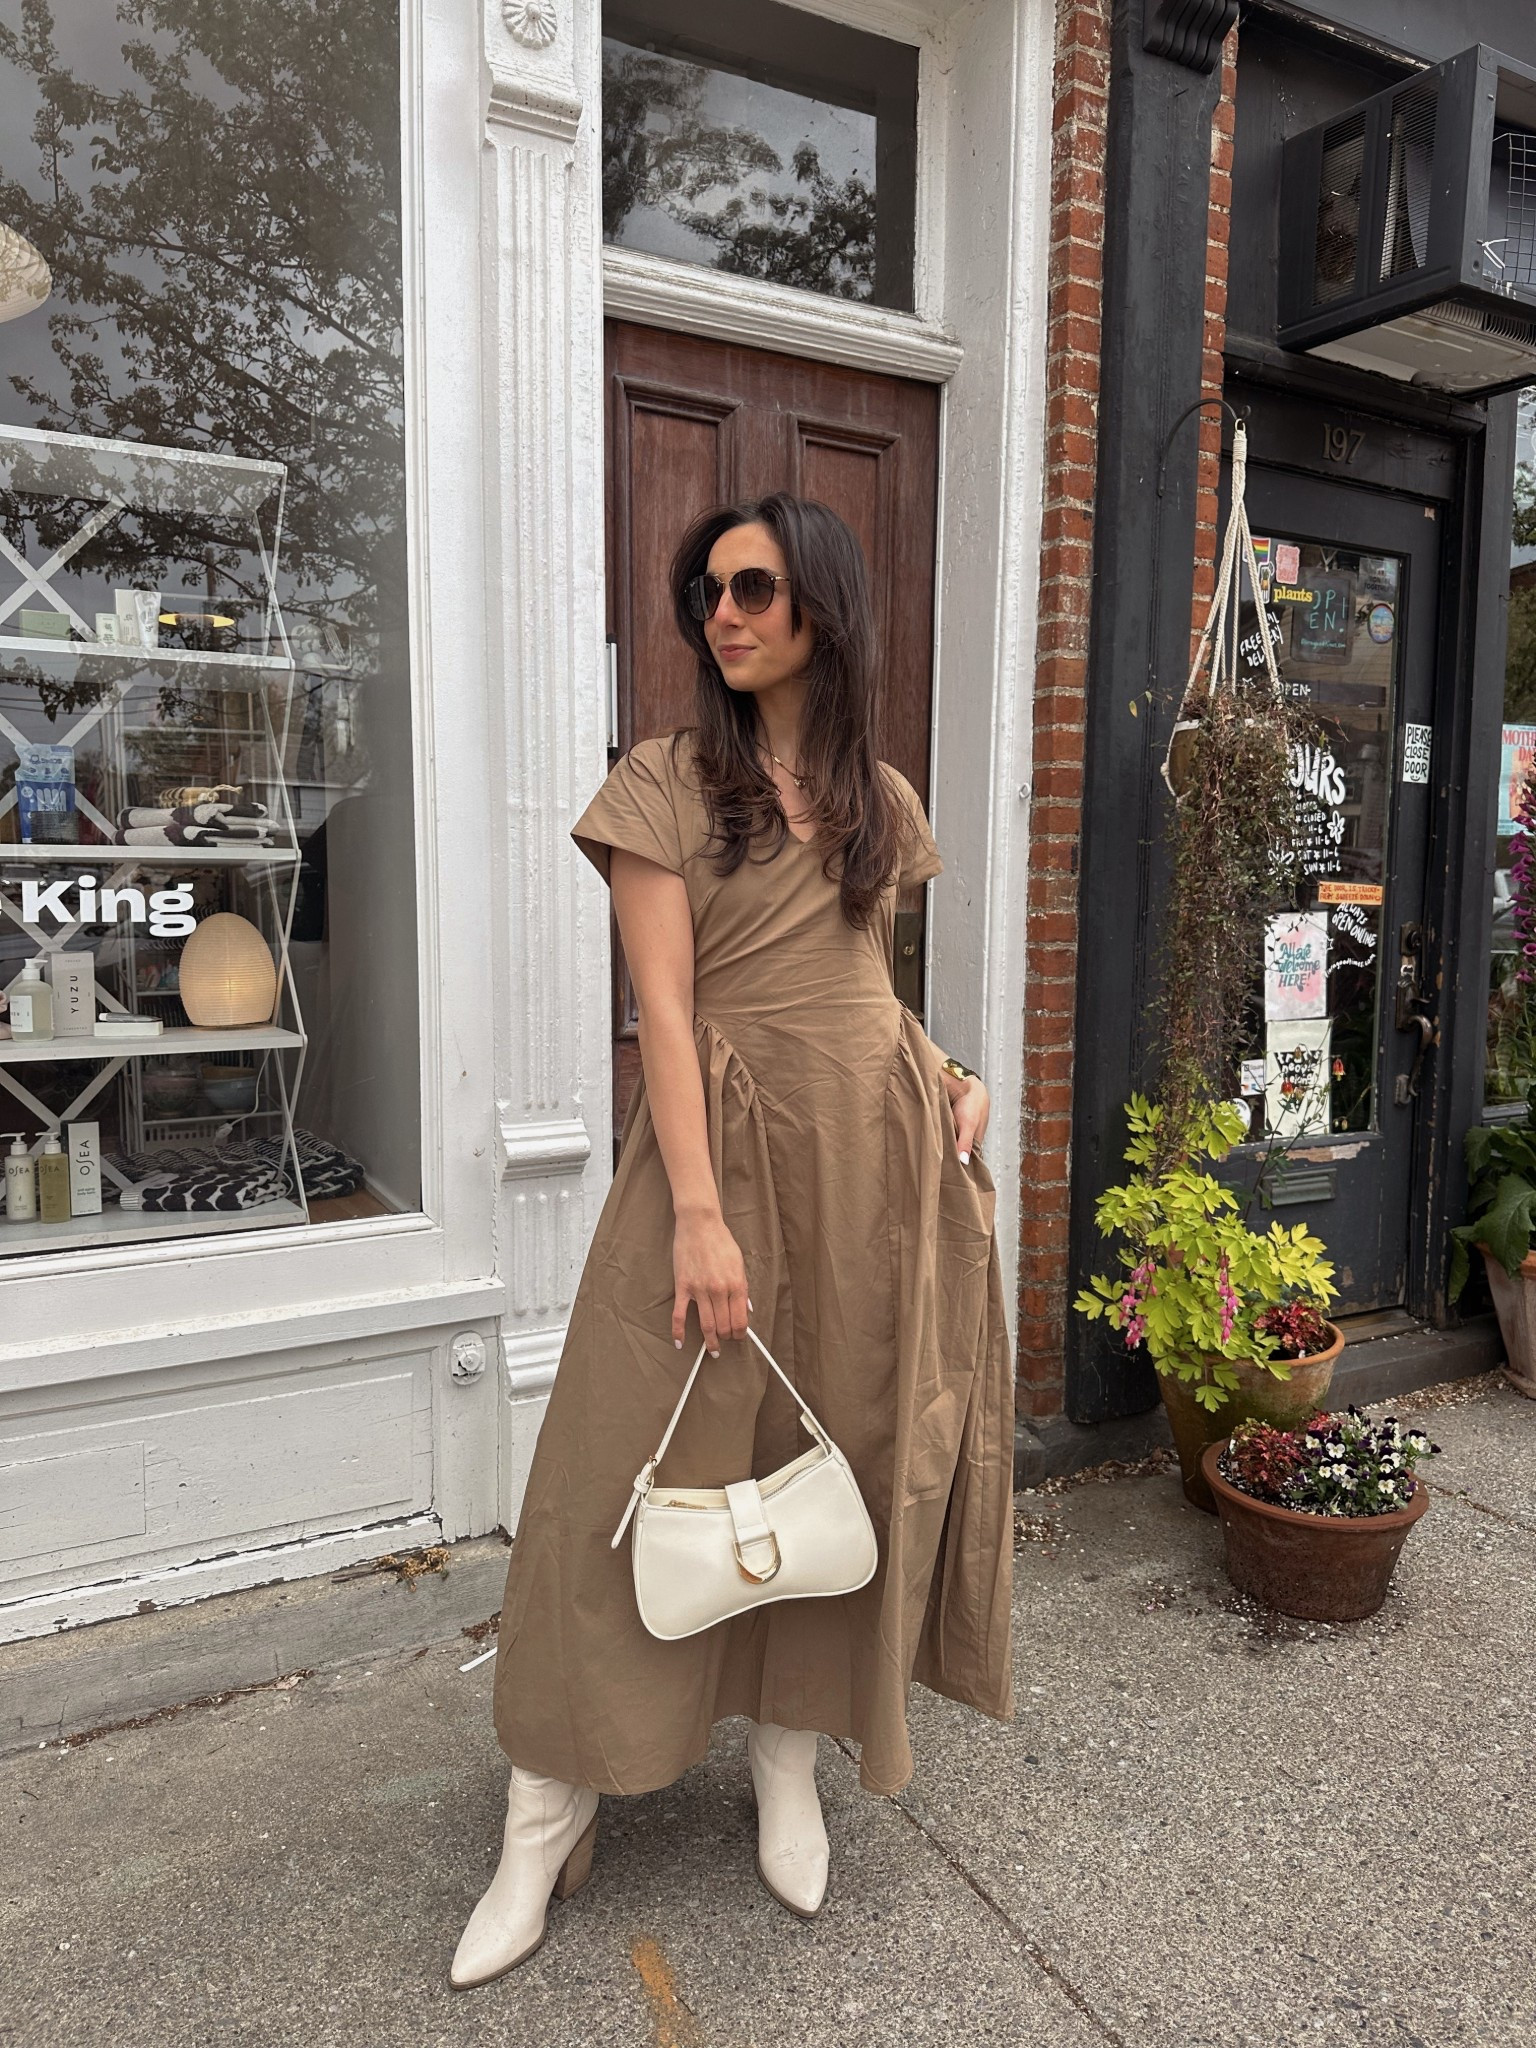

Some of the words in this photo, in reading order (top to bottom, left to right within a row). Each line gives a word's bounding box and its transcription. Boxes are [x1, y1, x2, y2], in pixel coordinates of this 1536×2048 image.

[1322, 422, 1367, 464] 197
[1273, 586, 1313, 604] plants
[1239, 632, 1261, 657] FREE
[1407, 726, 1431, 747] PLEASE
[1405, 746, 1429, 760] CLOSE
[1288, 743, 1346, 806] OURS
[1404, 761, 1427, 777] DOOR
[1303, 811, 1327, 823] CLOSED
[1315, 834, 1330, 846] 11-6
[1322, 846, 1339, 859] 11-6
[1303, 863, 1319, 876] SUN
[1327, 859, 1342, 872] 11-6
[21, 874, 197, 938] King
[1336, 901, 1368, 925] ALWAYS
[1331, 911, 1354, 932] OPEN
[1349, 924, 1378, 948] ONLINE
[1295, 944, 1312, 961] are
[1278, 959, 1320, 975] welcome
[1278, 972, 1311, 992] HERE!
[70, 974, 80, 1015] YUZU
[76, 1140, 95, 1176] OSEA
[8, 1165, 30, 1177] OSEA
[40, 1164, 60, 1176] OSEA
